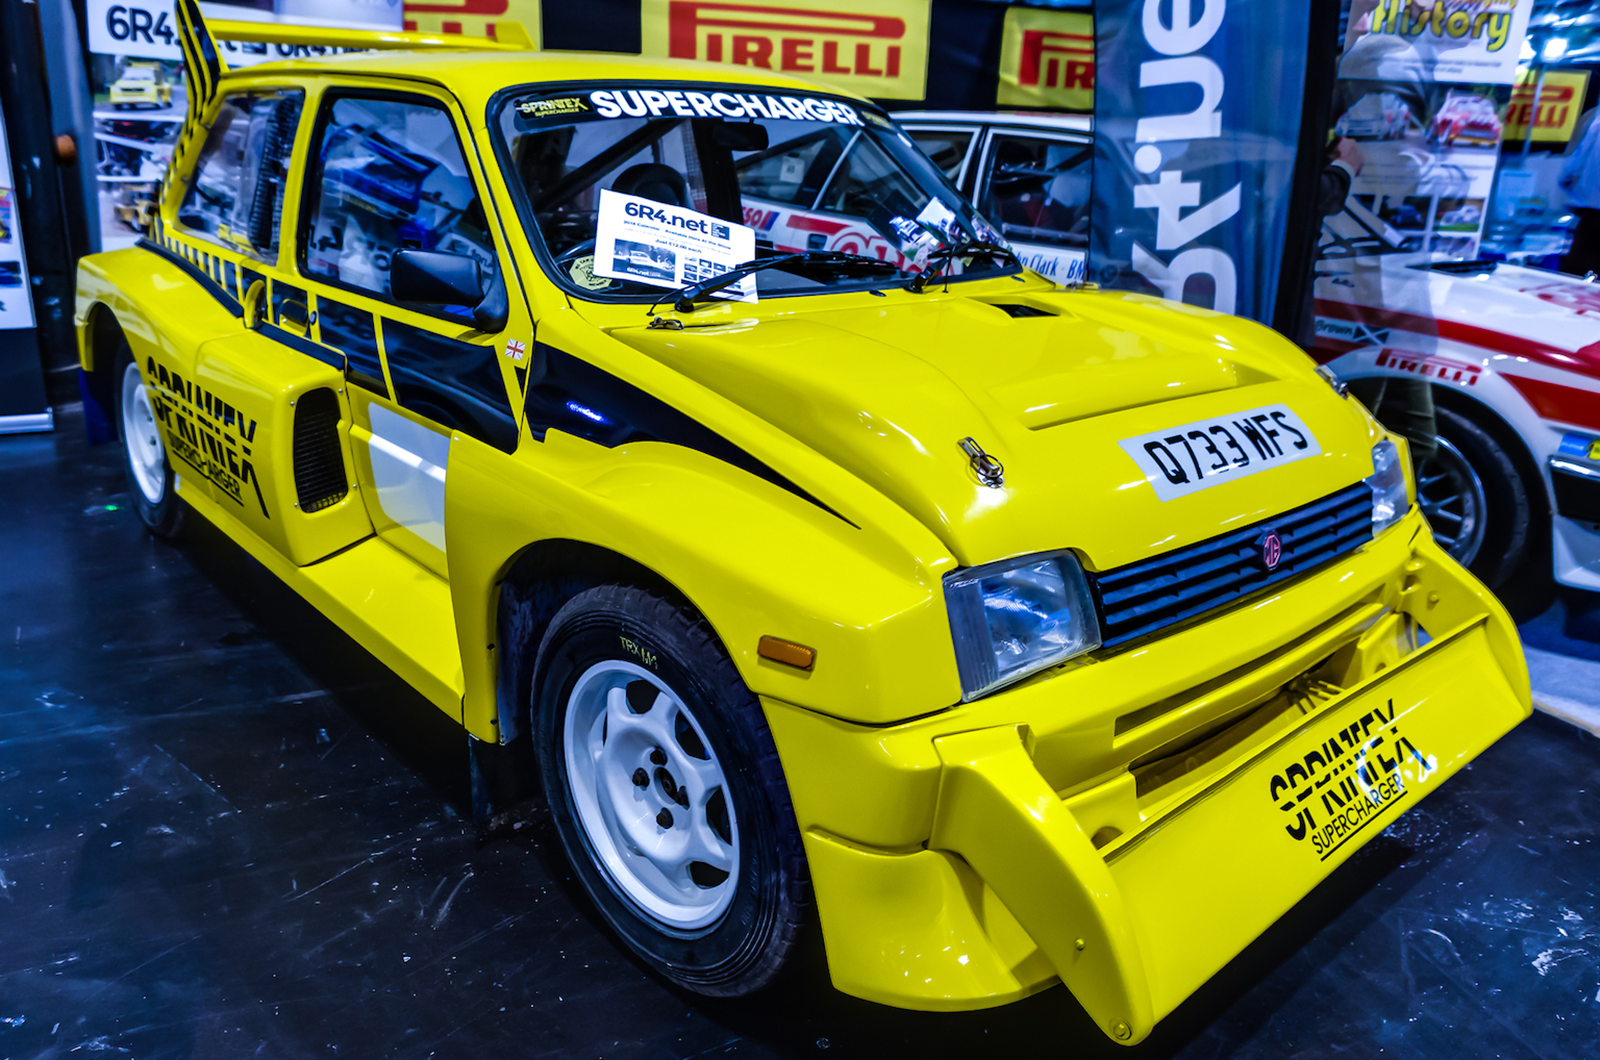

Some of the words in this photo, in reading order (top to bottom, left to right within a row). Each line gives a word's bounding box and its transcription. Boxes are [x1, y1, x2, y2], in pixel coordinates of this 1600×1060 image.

[668, 0, 906, 78] PIRELLI
[590, 91, 866, 127] SUPERCHARGER
[624, 201, 709, 235] 6R4.net
[1029, 253, 1060, 276] Clark
[1375, 348, 1483, 386] PIRELLI
[1143, 425, 1250, 485] Q733
[1232, 411, 1308, 461] WFS
[1264, 533, 1281, 568] MG
[1311, 772, 1406, 855] SUPERCHARGER
